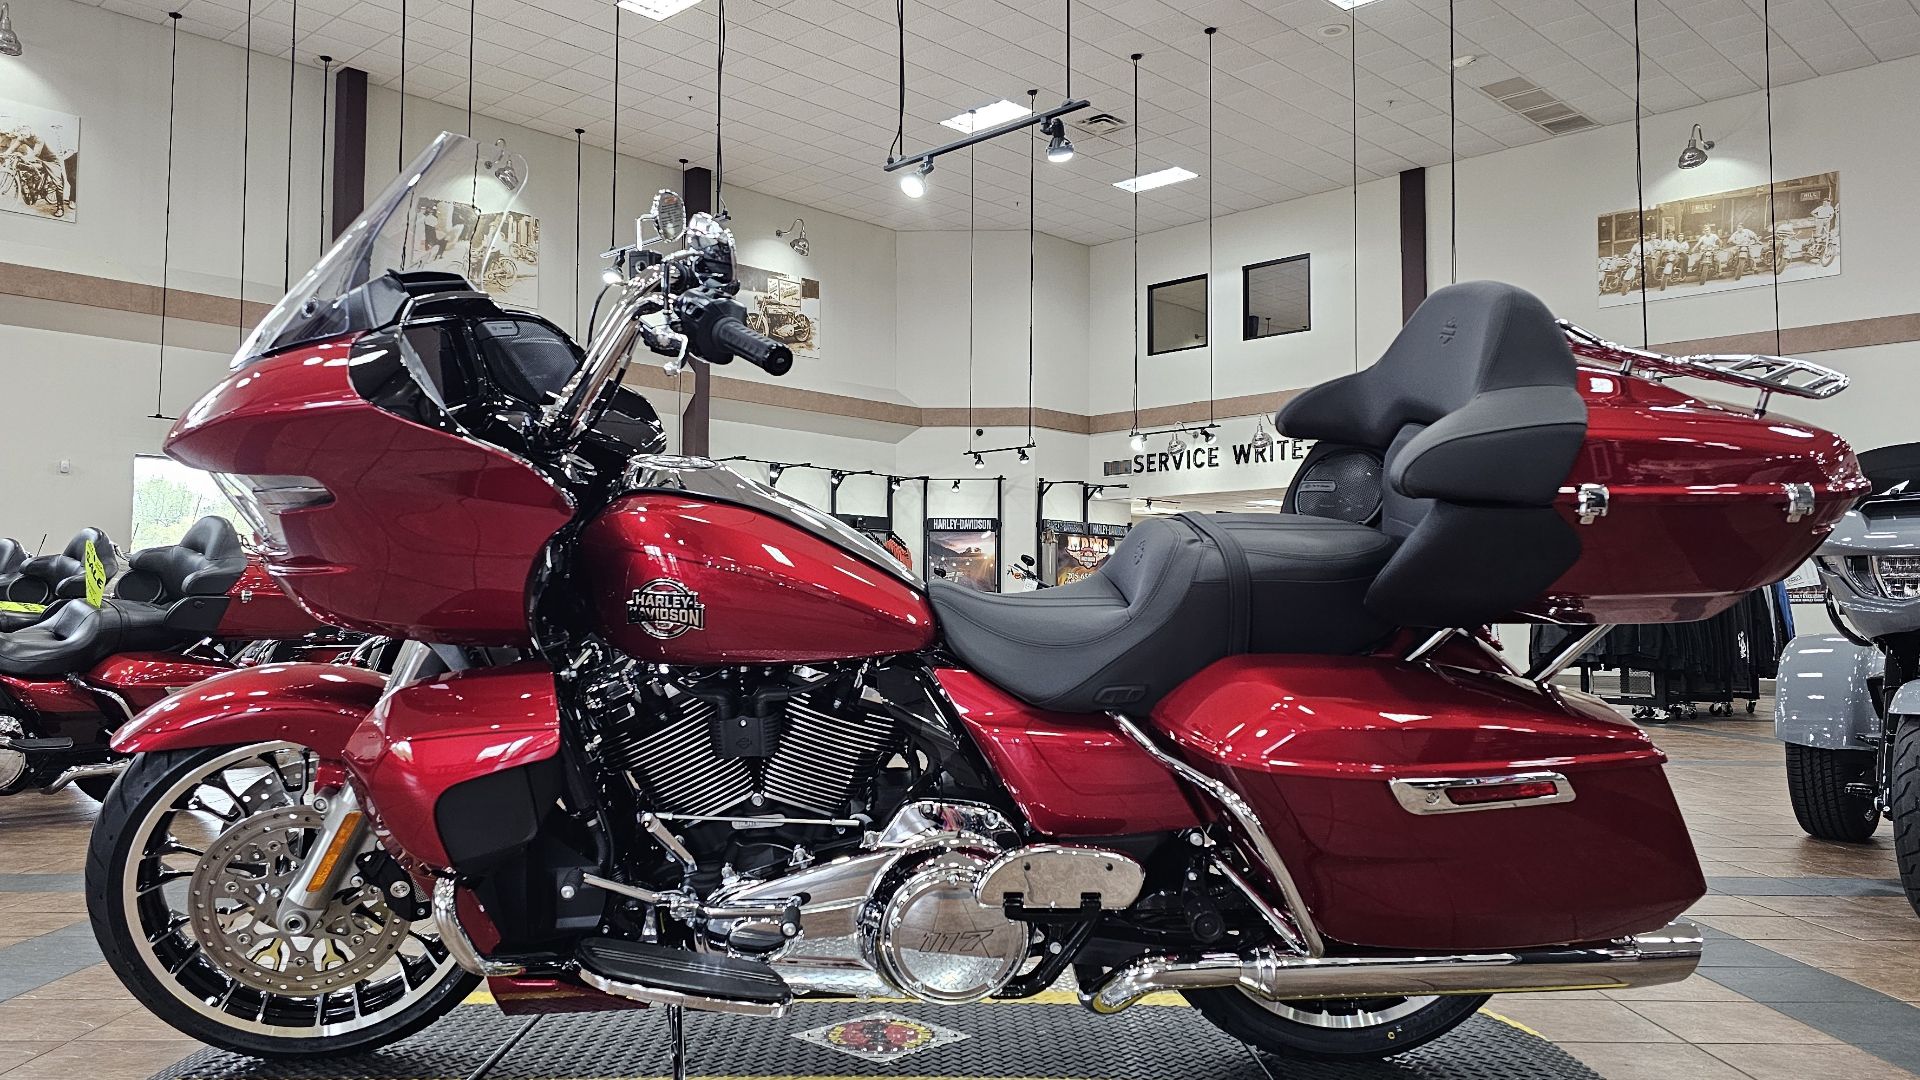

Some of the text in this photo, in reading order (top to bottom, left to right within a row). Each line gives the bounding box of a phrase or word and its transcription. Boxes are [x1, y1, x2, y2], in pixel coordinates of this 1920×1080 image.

[1133, 438, 1313, 474] SERVICE WRITE
[933, 518, 992, 530] HARLEY-DAVIDSON
[635, 594, 694, 608] HARLEY-
[919, 929, 994, 953] 117
